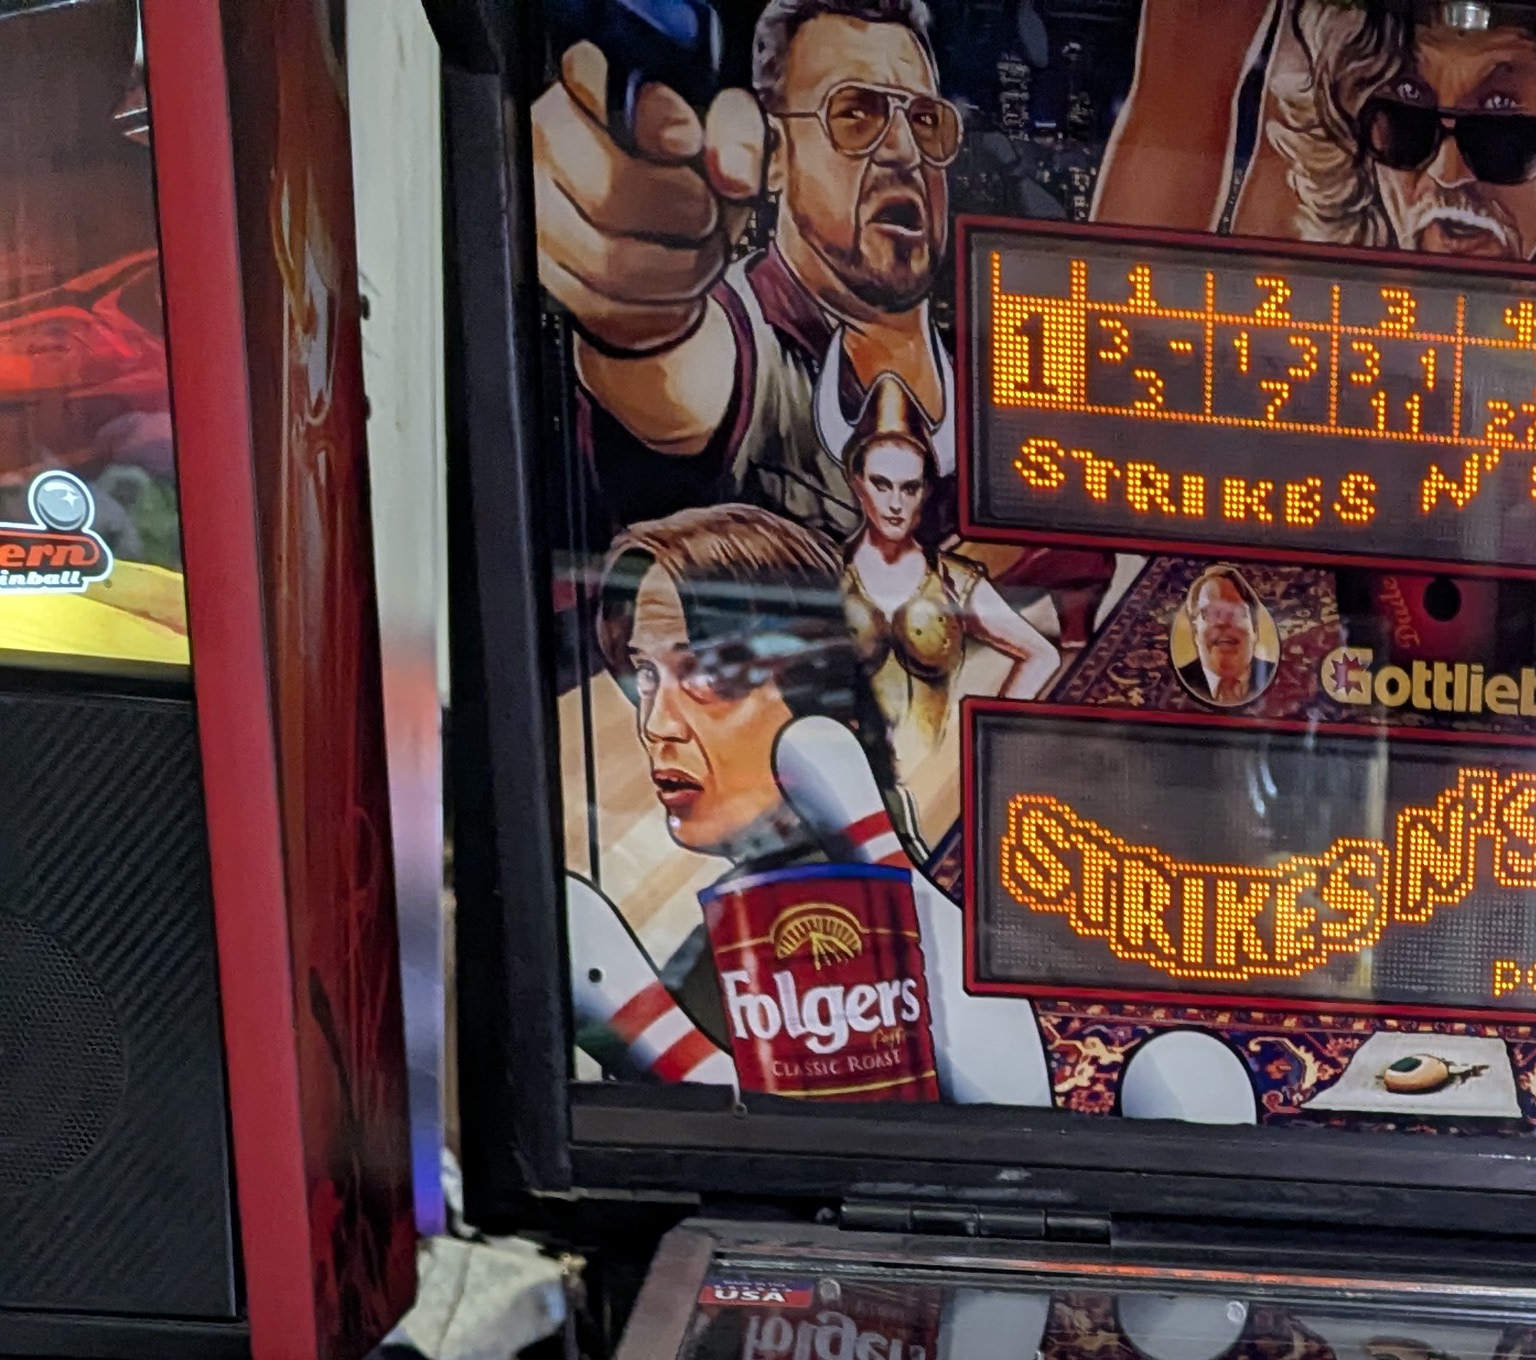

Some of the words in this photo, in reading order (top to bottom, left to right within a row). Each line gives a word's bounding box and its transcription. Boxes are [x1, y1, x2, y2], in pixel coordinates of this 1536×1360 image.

[1128, 264, 1158, 307] 1
[1255, 275, 1291, 319] 2
[1380, 288, 1417, 332] 3
[1099, 319, 1130, 362] 3
[1134, 367, 1164, 411] 3
[1259, 379, 1291, 422] 7
[1013, 436, 1378, 526] STRIKES
[1003, 796, 1385, 978] STRIKES
[720, 968, 921, 1055] Folgers
[771, 1060, 840, 1077] CLASSIC
[846, 1048, 902, 1073] ROAST
[713, 1287, 786, 1303] USA
